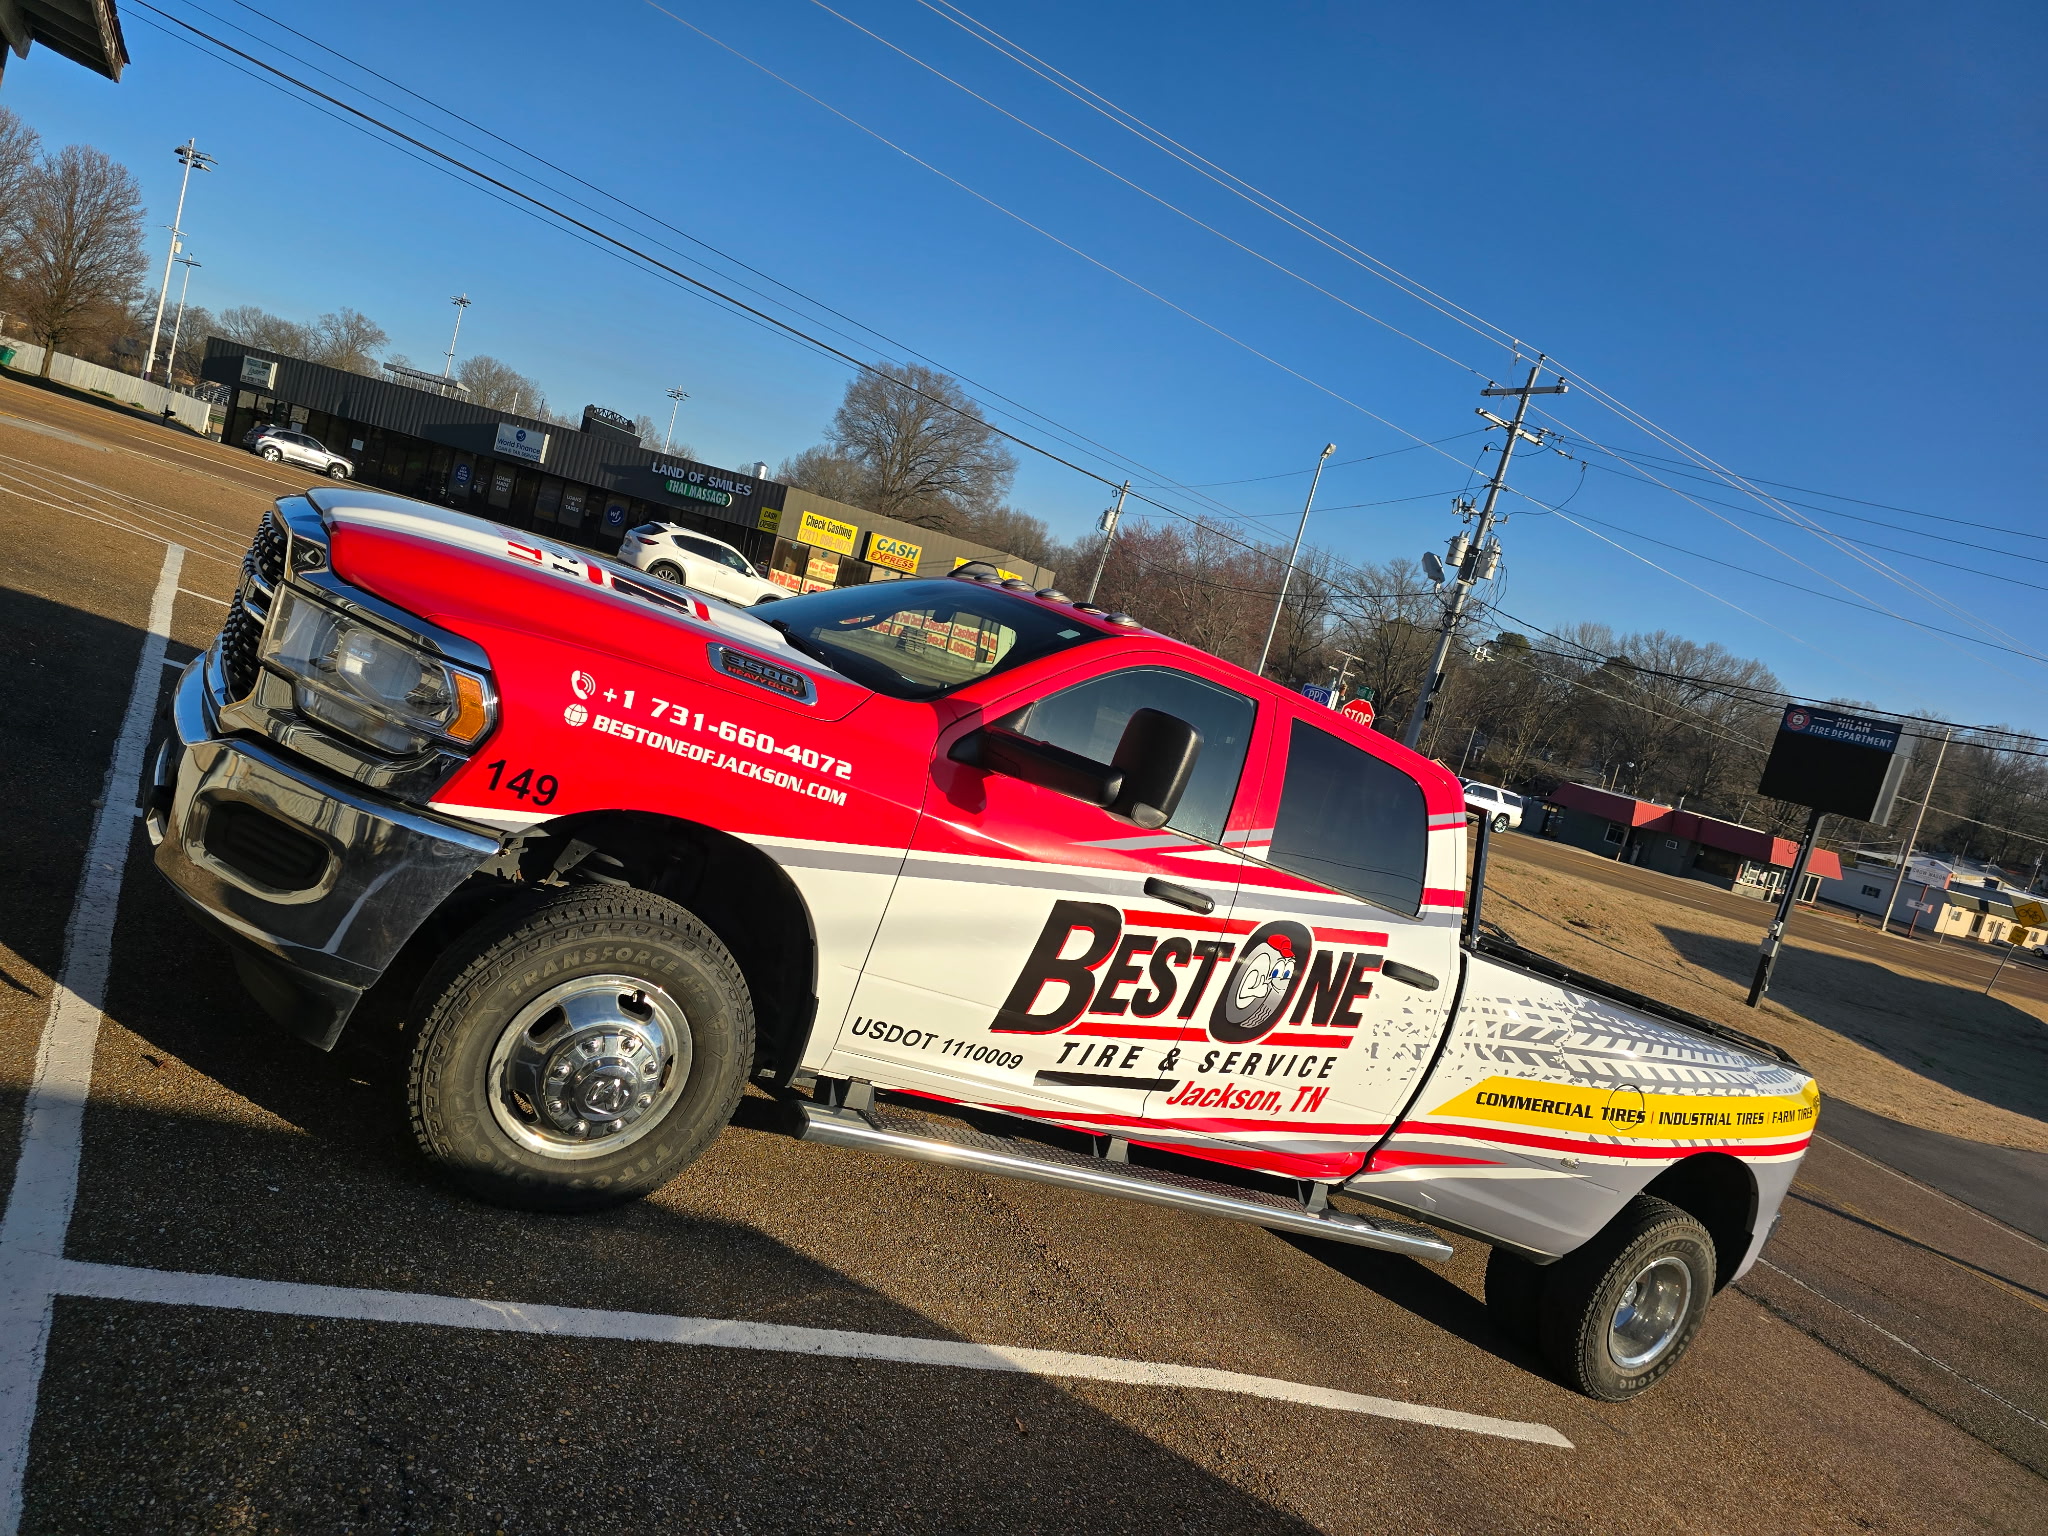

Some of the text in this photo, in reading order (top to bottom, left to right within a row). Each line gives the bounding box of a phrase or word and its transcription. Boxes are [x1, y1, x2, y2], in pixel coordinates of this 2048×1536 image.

[497, 438, 541, 455] World Finance
[651, 461, 752, 496] LAND OF SMILES
[667, 479, 728, 506] THAI MASSAGE
[566, 494, 582, 503] LOANS
[805, 514, 853, 540] Check Cashing
[870, 549, 915, 570] EXPRESS
[876, 538, 919, 560] CASH
[727, 655, 799, 687] 3500
[727, 665, 800, 696] HEAVY DUTY
[1344, 707, 1372, 726] STOP
[1835, 718, 1872, 734] MILAN
[602, 687, 853, 781] +1 731-660-4072
[1809, 724, 1894, 749] FIRE DEPARTMENT
[591, 713, 848, 806] BESTONEOFJACKSON.COM
[485, 758, 560, 807] 149
[505, 945, 681, 998] TRANSFORCE
[851, 1016, 1024, 1070] USDOT 1110009
[1056, 1042, 1339, 1079] TIRE & SERVICE
[1165, 1080, 1331, 1116] Jackson, TN
[1475, 1090, 1813, 1127] COMMERCIAL TIRES INDUSTRIAL TIRES FARM TIRES
